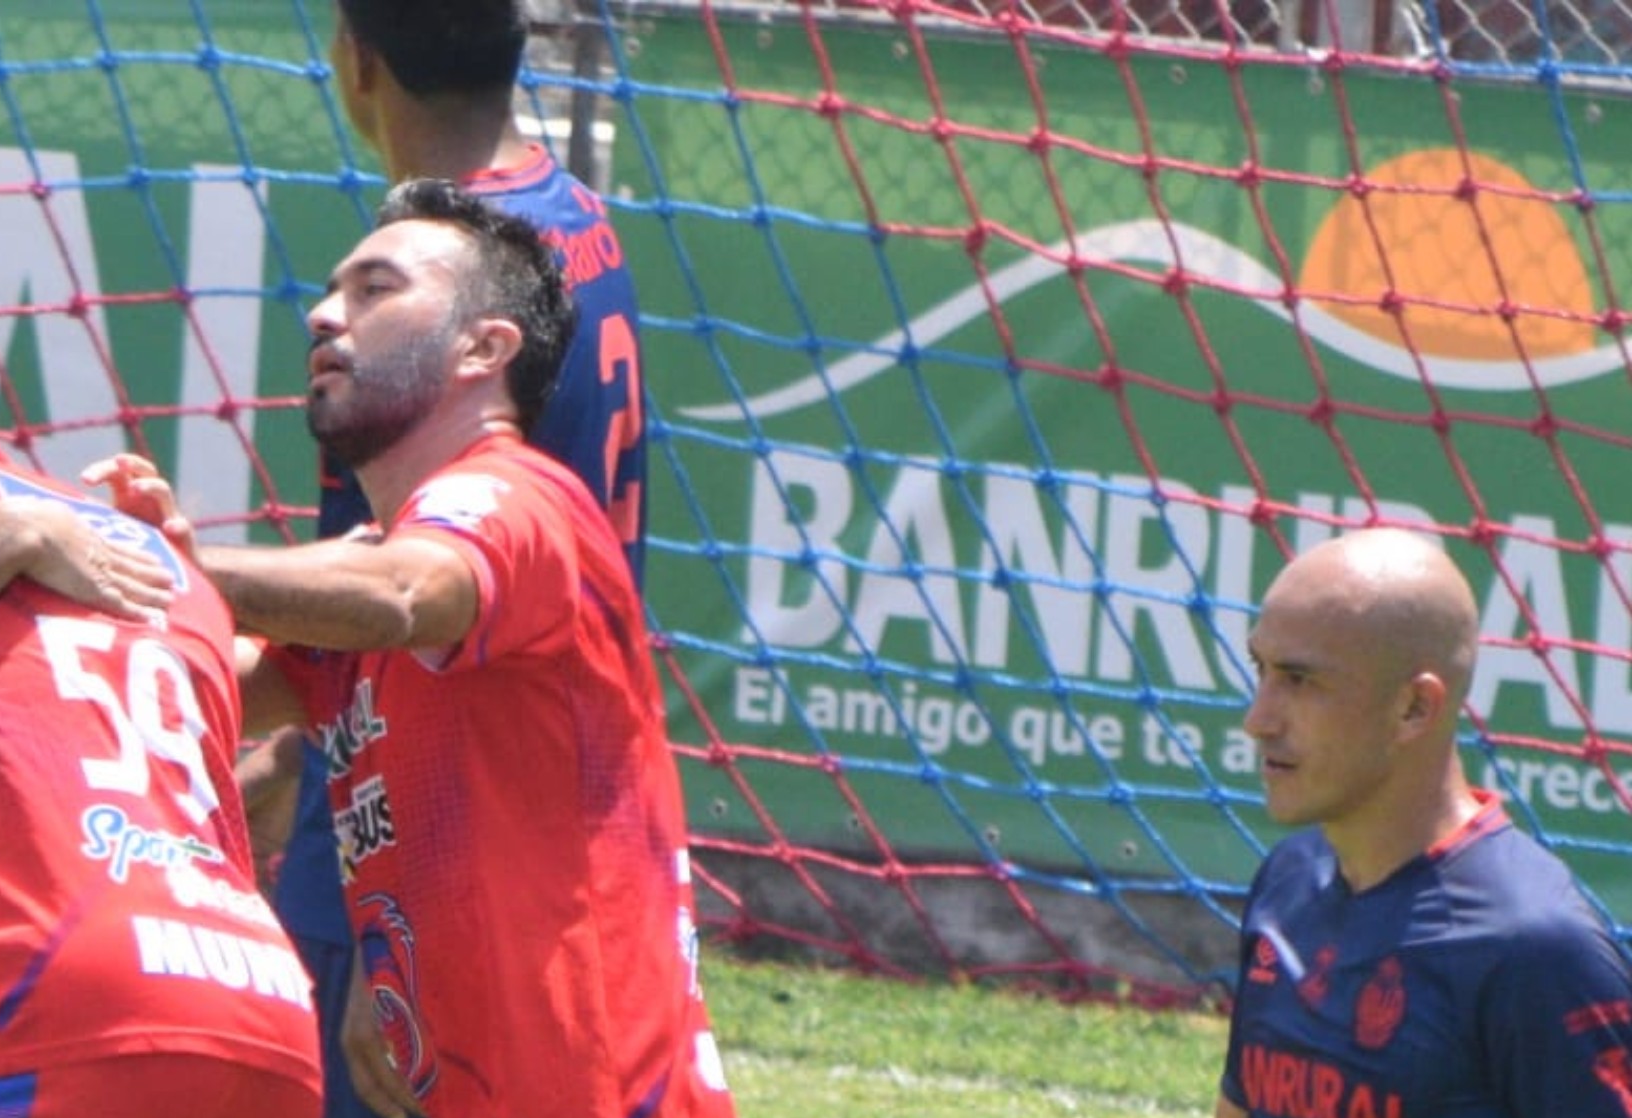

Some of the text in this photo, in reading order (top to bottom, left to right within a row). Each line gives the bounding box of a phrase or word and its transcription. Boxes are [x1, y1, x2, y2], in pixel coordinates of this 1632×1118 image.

[34, 615, 221, 826] 59
[734, 666, 788, 722] El
[805, 680, 991, 756] amigo
[1010, 706, 1125, 764] que
[1143, 704, 1204, 763] te
